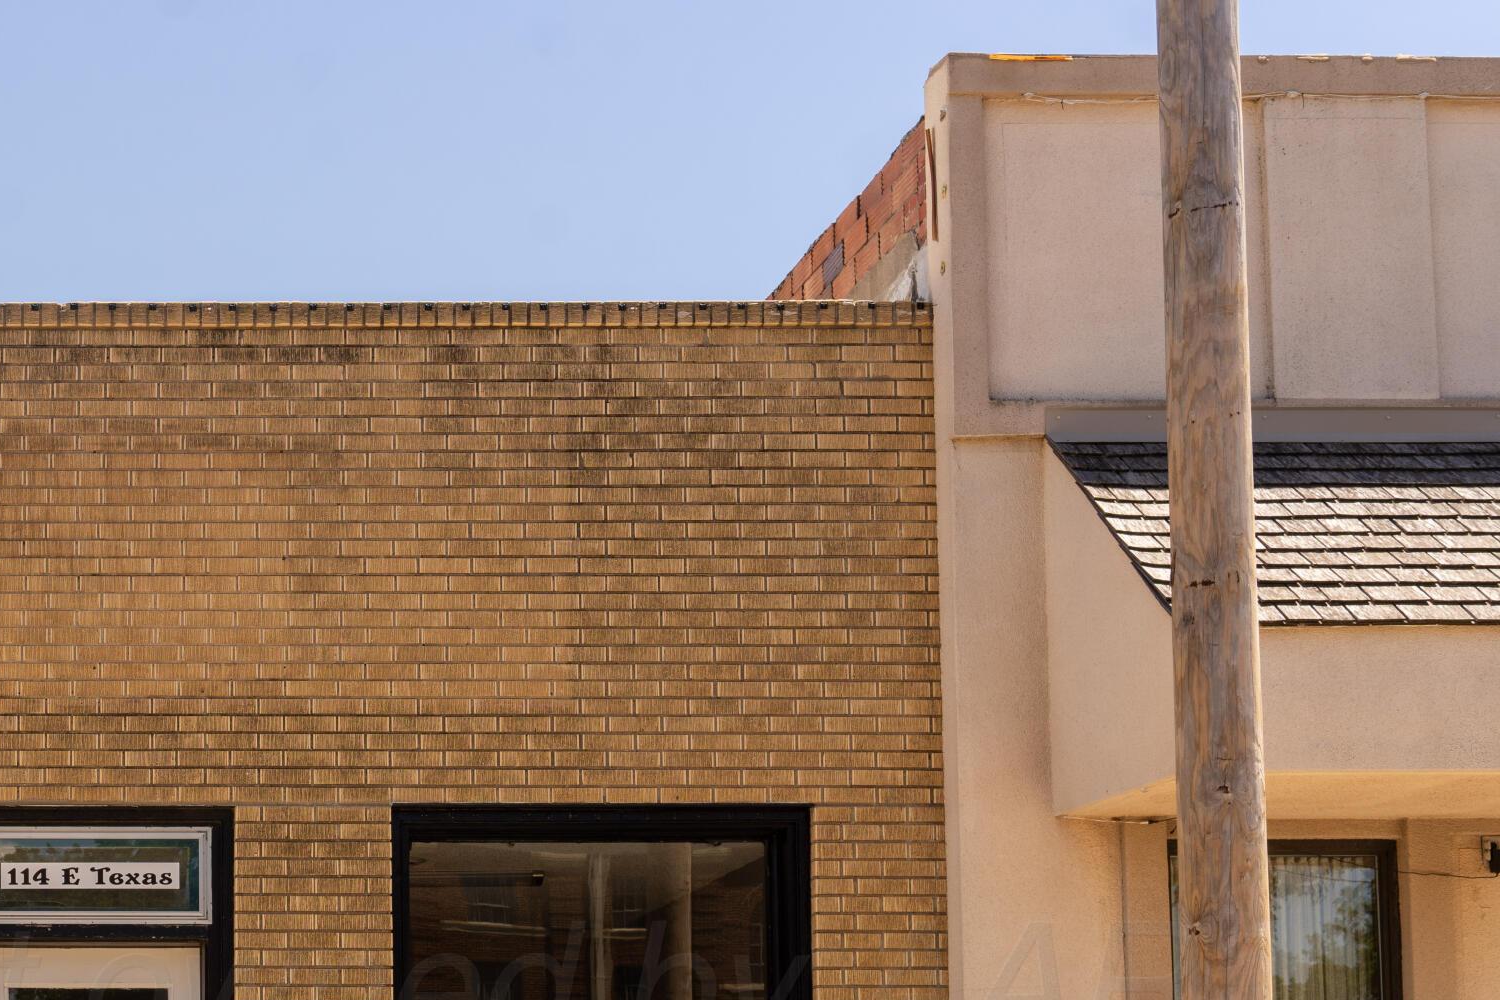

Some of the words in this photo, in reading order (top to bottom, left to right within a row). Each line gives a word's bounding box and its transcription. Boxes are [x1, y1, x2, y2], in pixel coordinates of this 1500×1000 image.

[6, 867, 50, 886] 114
[61, 867, 81, 886] E
[89, 866, 174, 886] Texas
